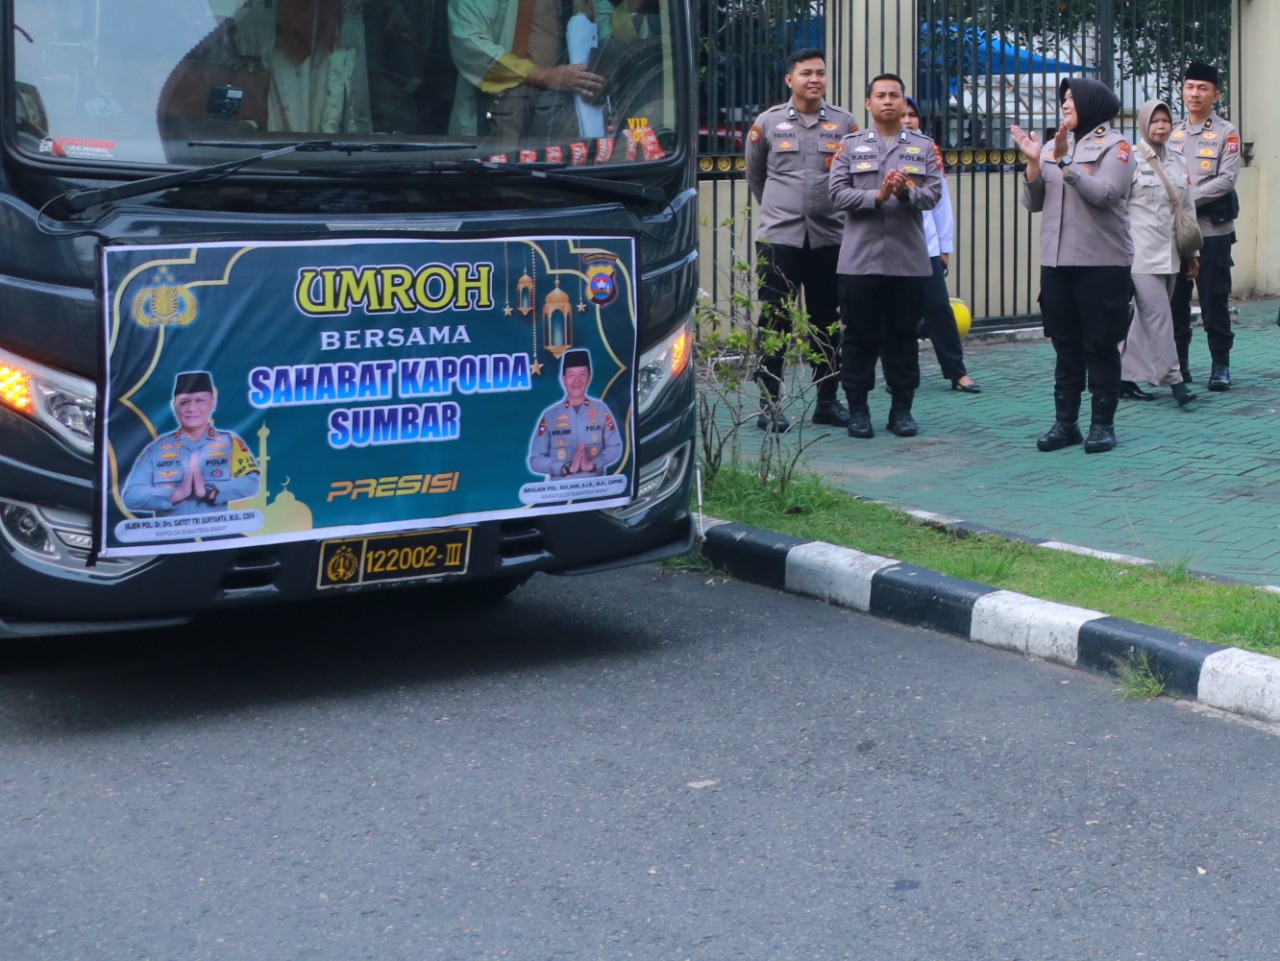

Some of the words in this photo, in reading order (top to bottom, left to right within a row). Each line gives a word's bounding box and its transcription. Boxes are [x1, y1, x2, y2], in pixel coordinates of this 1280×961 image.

[627, 117, 648, 130] VIP
[296, 262, 494, 317] UMROH
[320, 325, 471, 350] BERSAMA
[249, 360, 396, 409] SAHABAT
[399, 353, 531, 397] KAPOLDA
[328, 401, 460, 449] SUMBAR
[206, 458, 228, 466] POLRI
[327, 471, 460, 502] PRESISI
